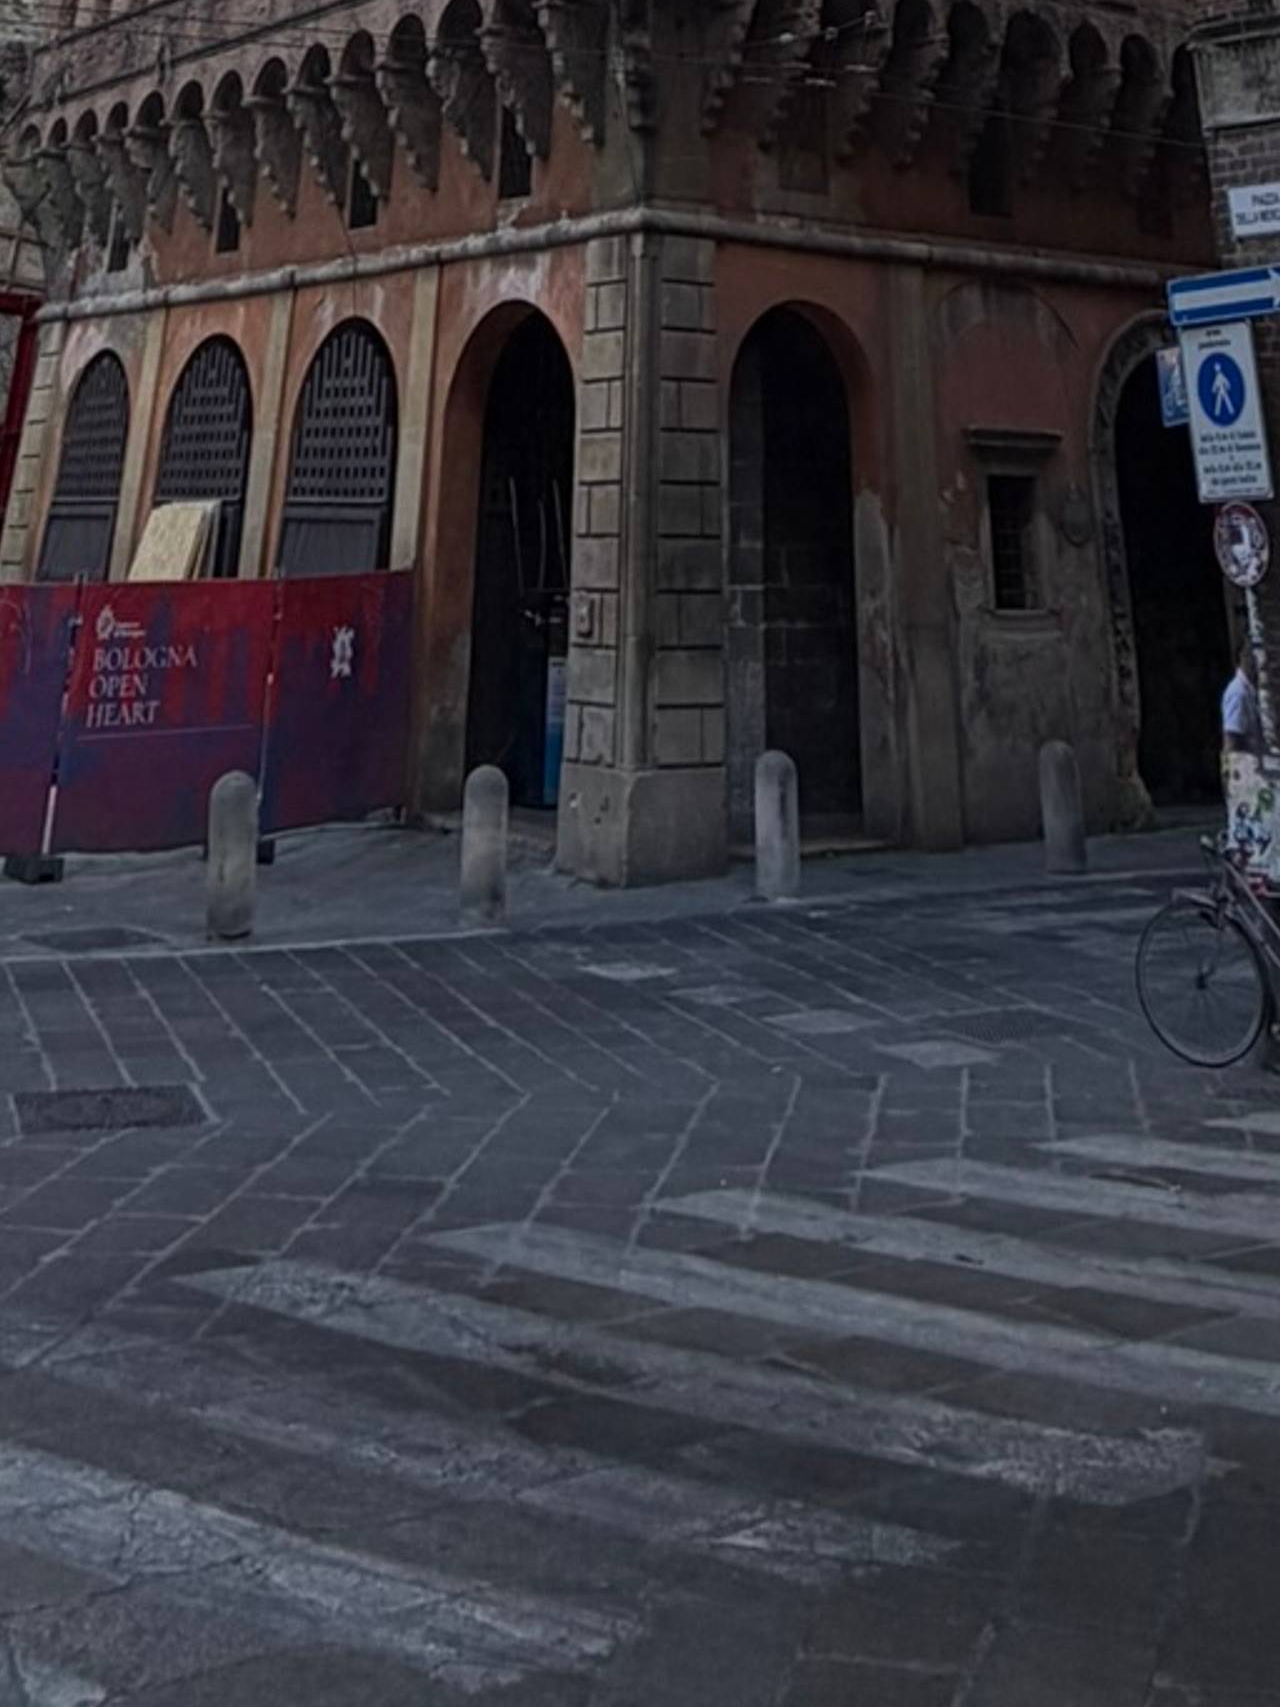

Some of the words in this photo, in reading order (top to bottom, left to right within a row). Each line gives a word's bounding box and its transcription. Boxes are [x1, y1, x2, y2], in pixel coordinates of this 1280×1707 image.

[93, 644, 198, 672] BOLOGNA
[88, 673, 148, 699] OPEN
[85, 700, 160, 729] HEART
